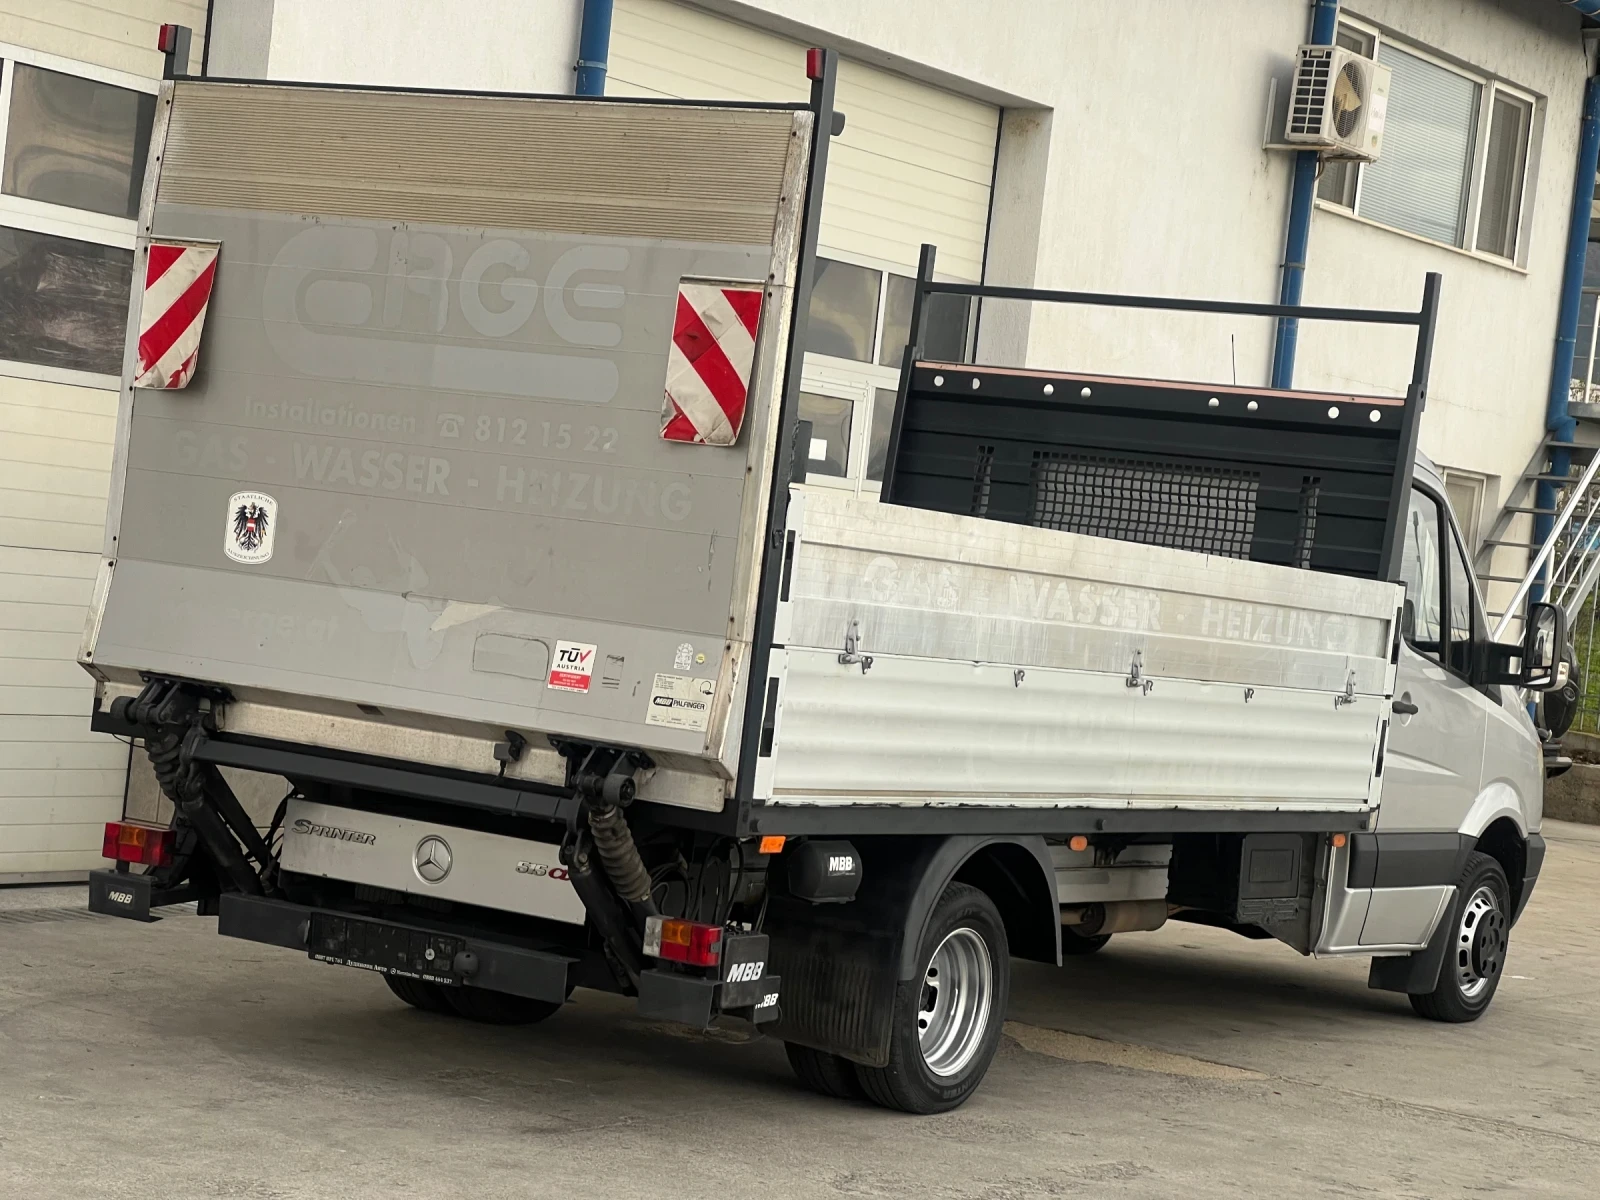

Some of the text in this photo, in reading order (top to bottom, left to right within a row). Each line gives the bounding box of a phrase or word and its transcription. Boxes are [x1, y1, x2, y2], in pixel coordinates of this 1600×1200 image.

[243, 394, 417, 435] Installationen
[474, 415, 620, 454] 812 15 22
[172, 429, 250, 474] GAS
[292, 441, 452, 497] WASSER
[498, 464, 692, 522] HEIZUNG
[1008, 573, 1163, 632] WASSER
[1201, 599, 1350, 649] HEIZUNG
[559, 647, 592, 663] TÜV
[556, 663, 585, 672] AUSTRIA
[672, 700, 706, 711] PALFINGER
[515, 860, 549, 878] 515
[829, 856, 853, 872] MBB
[108, 891, 133, 905] MBB
[726, 961, 765, 983] MBB
